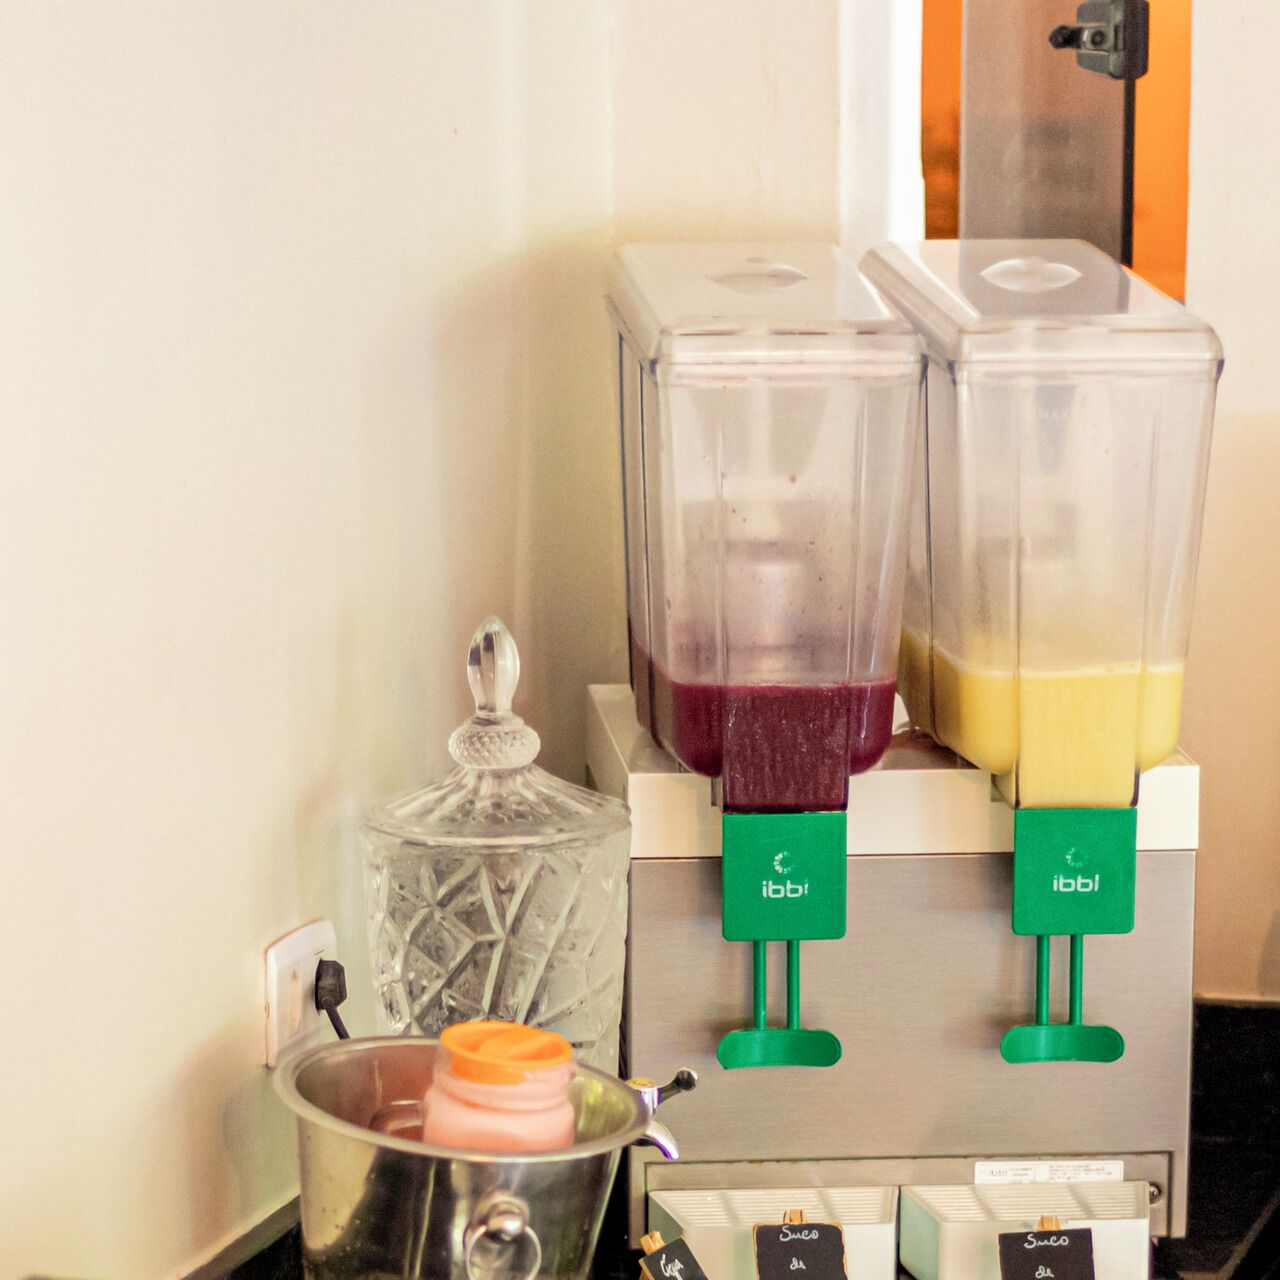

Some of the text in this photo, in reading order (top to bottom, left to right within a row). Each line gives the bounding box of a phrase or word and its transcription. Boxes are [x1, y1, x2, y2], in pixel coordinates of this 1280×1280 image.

[779, 1225, 819, 1242] Suco
[1023, 1233, 1069, 1249] Suco
[789, 1257, 807, 1271] de
[1035, 1265, 1055, 1279] de
